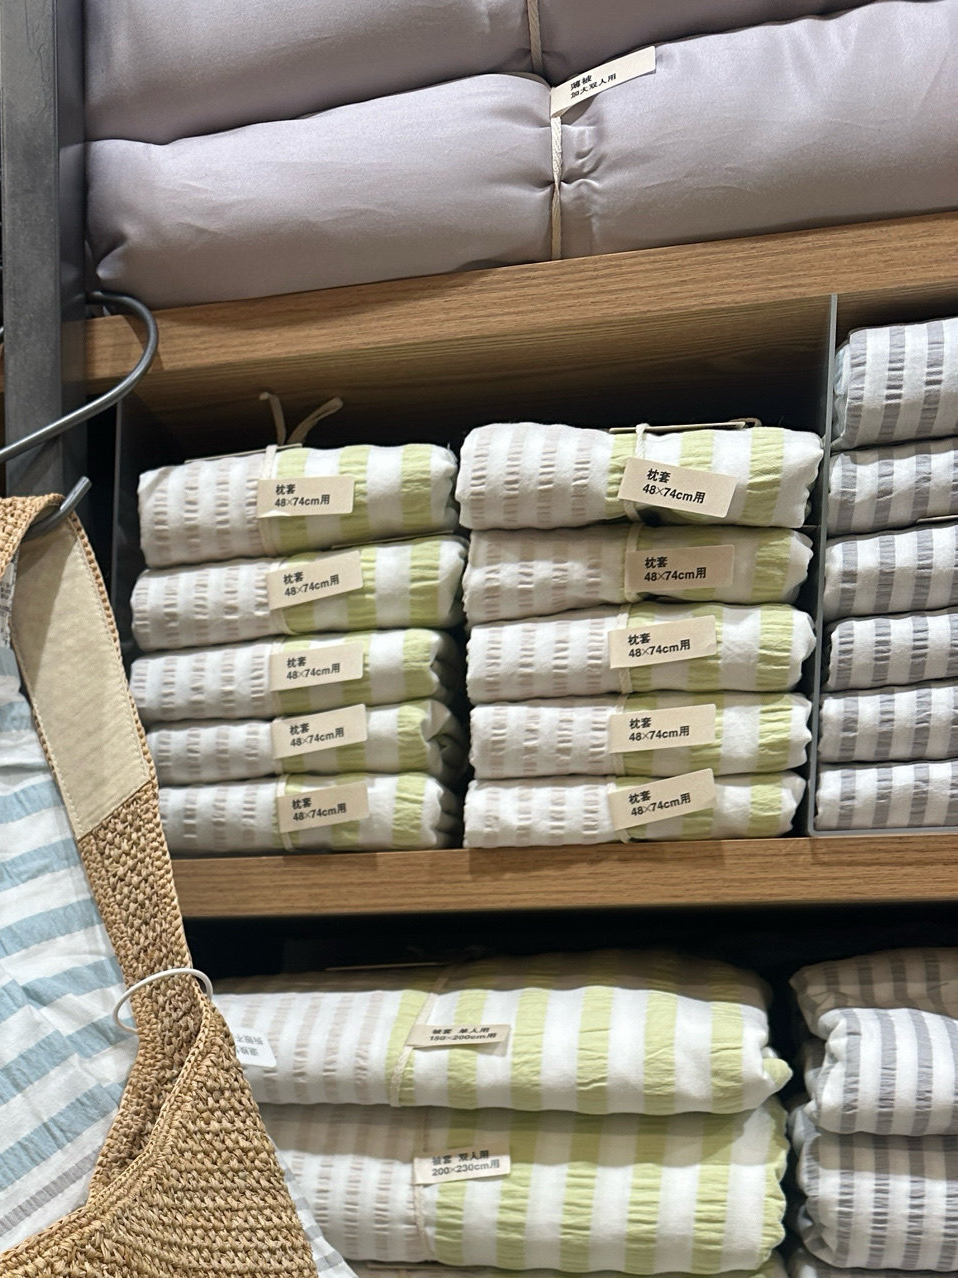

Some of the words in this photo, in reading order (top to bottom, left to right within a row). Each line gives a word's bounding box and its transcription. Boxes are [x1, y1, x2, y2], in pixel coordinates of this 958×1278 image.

[647, 468, 671, 483] 枕套
[276, 484, 296, 495] 枕套
[642, 484, 706, 504] 48×74cm用
[274, 494, 330, 507] 48×74cm用
[644, 556, 668, 569] 枕套
[283, 571, 304, 585] 枕套
[644, 567, 707, 582] 48×74cm用
[284, 574, 340, 596] 48×74cm用
[628, 632, 651, 646] 枕套
[628, 639, 691, 658] 48×74cm用
[287, 656, 306, 668] 枕套
[286, 663, 341, 680] 48×74cm用
[290, 723, 309, 735] 枕套
[629, 717, 651, 729] 枕套
[290, 727, 345, 747] 48×74cm用
[629, 725, 690, 741] 48×74cm用
[292, 797, 312, 810] 枕套
[628, 790, 651, 805] 枕套
[631, 792, 691, 816] 48×74cm用
[293, 802, 347, 821] 48×74cm用
[432, 1155, 453, 1166] 被套
[458, 1150, 490, 1162] 双人用
[431, 1158, 501, 1177] 200×230cm用
